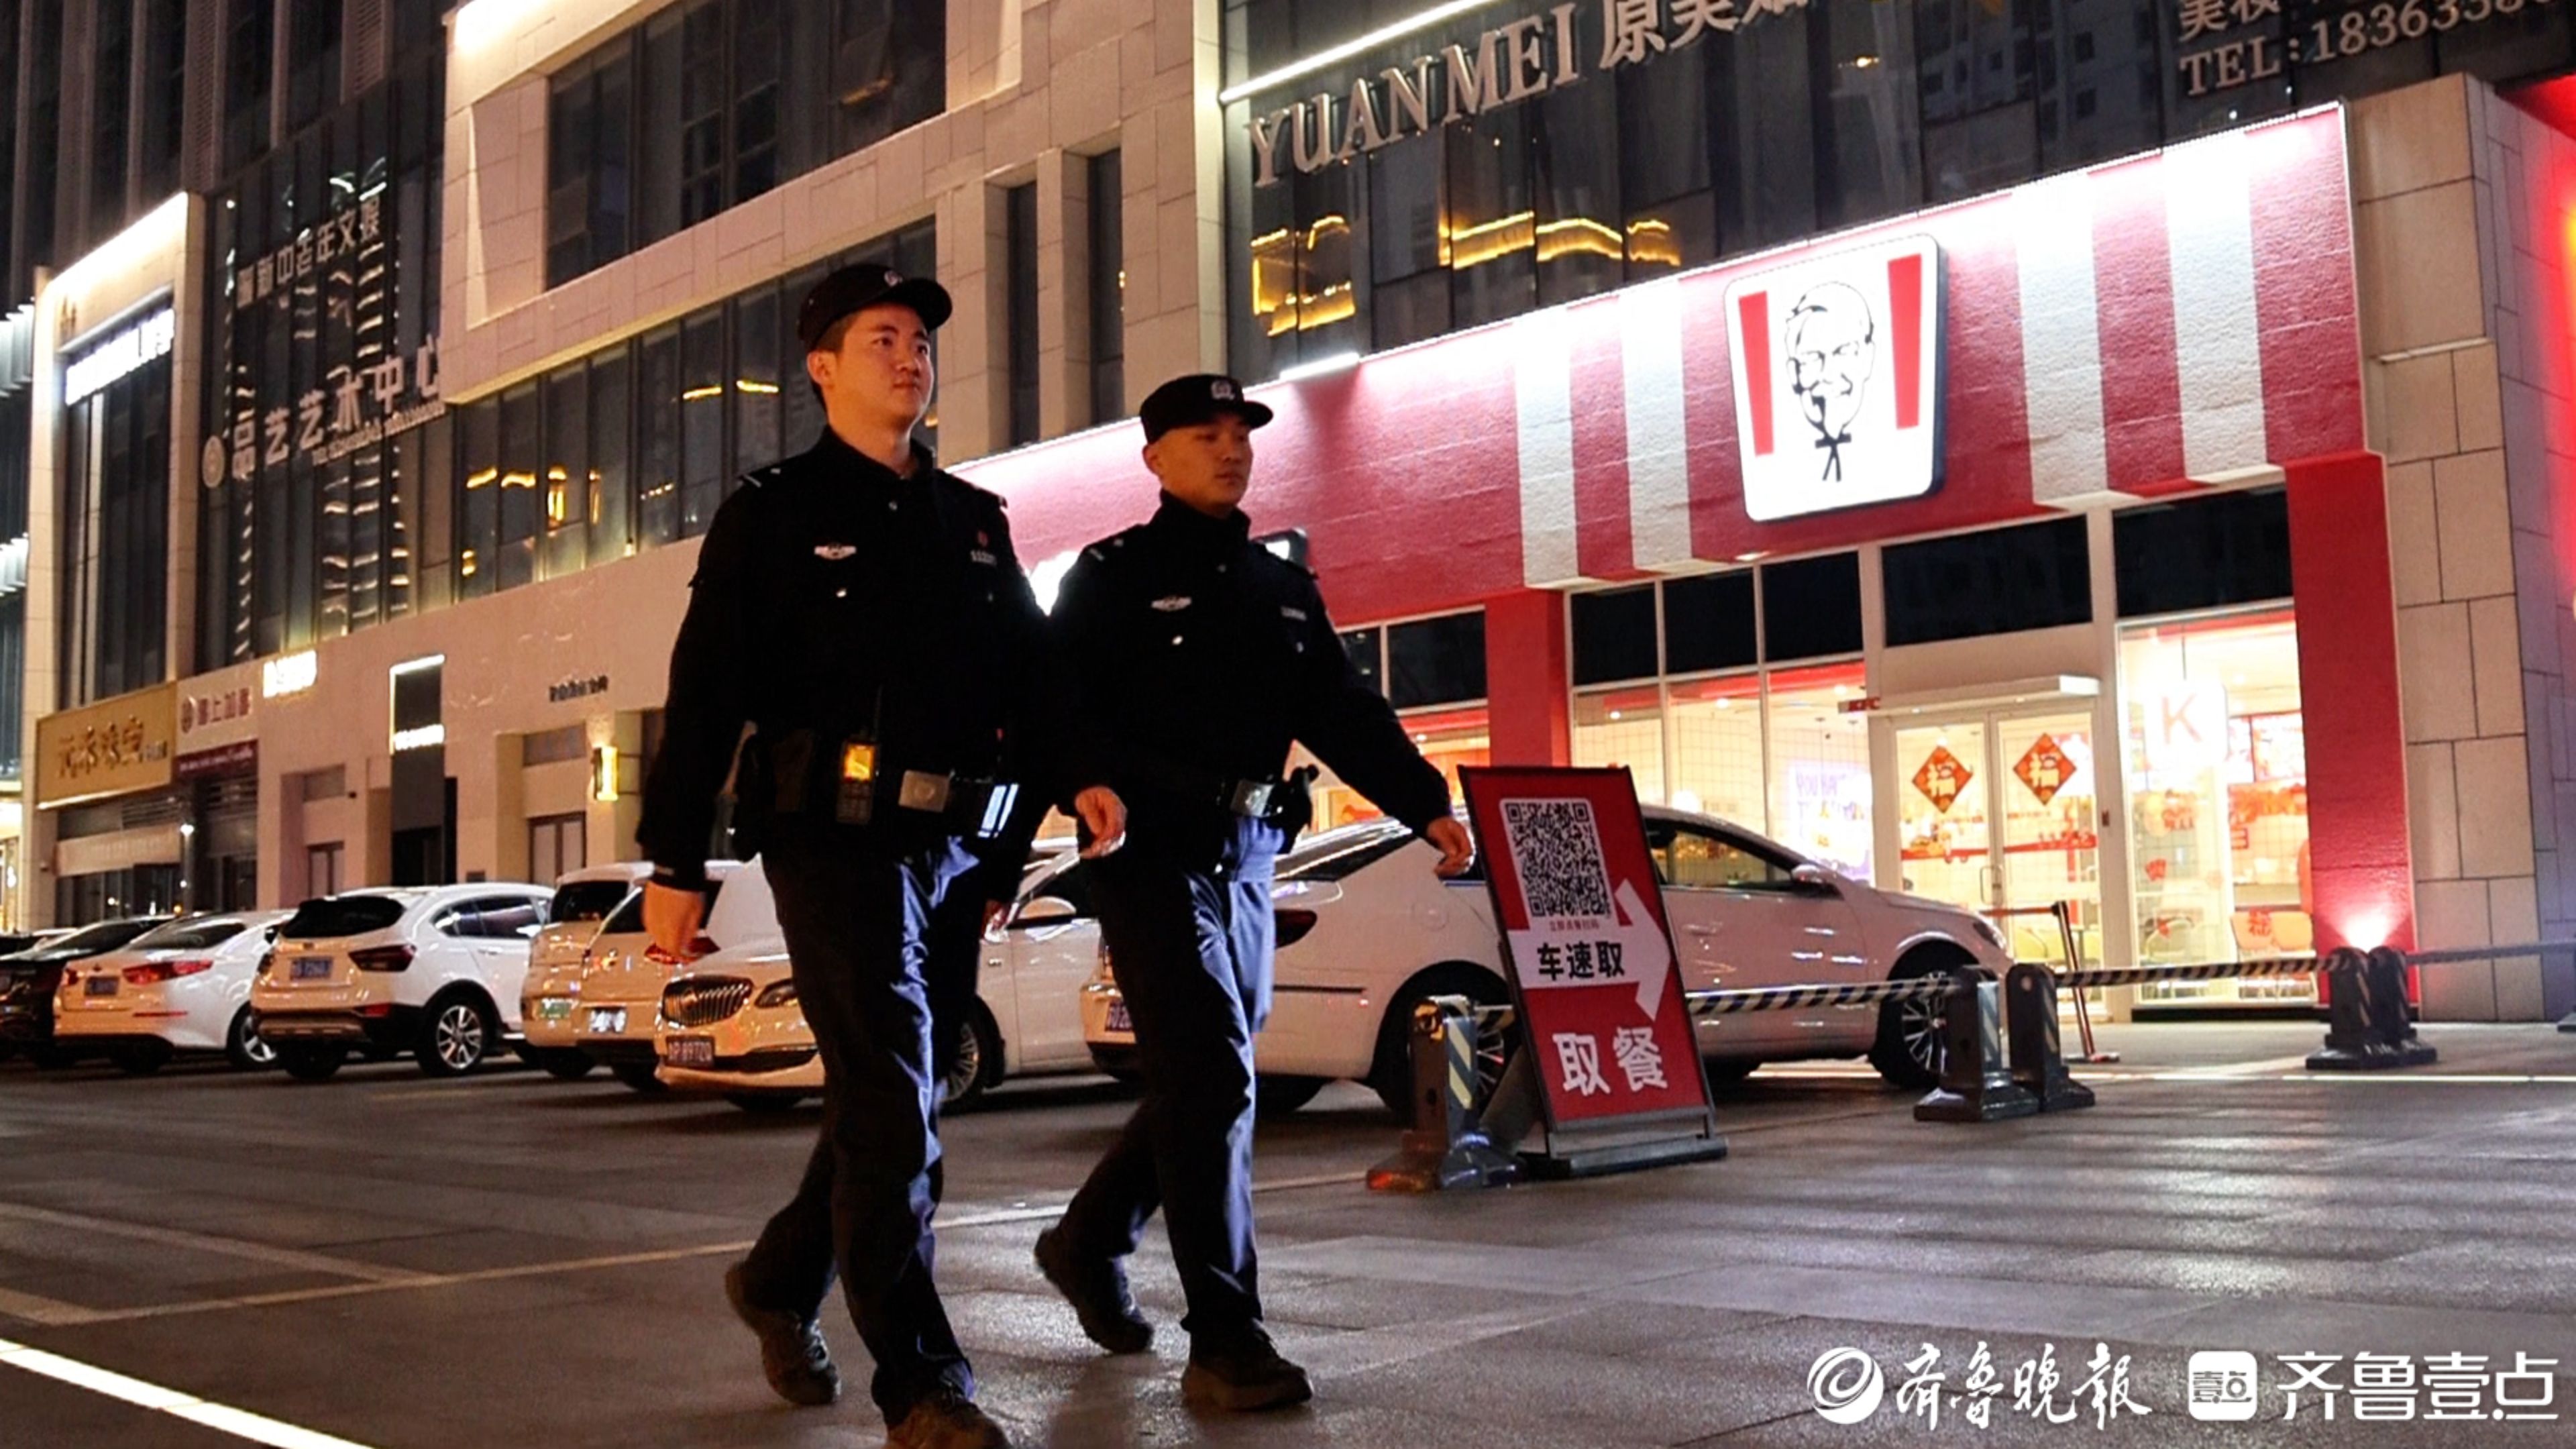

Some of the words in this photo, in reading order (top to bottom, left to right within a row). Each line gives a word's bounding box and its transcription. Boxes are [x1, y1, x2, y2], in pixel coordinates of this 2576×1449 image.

[1599, 0, 1810, 68] 原美
[1246, 3, 1585, 188] YUANMEI
[1537, 941, 1625, 981] 车速取
[1552, 1026, 1668, 1097] 取餐
